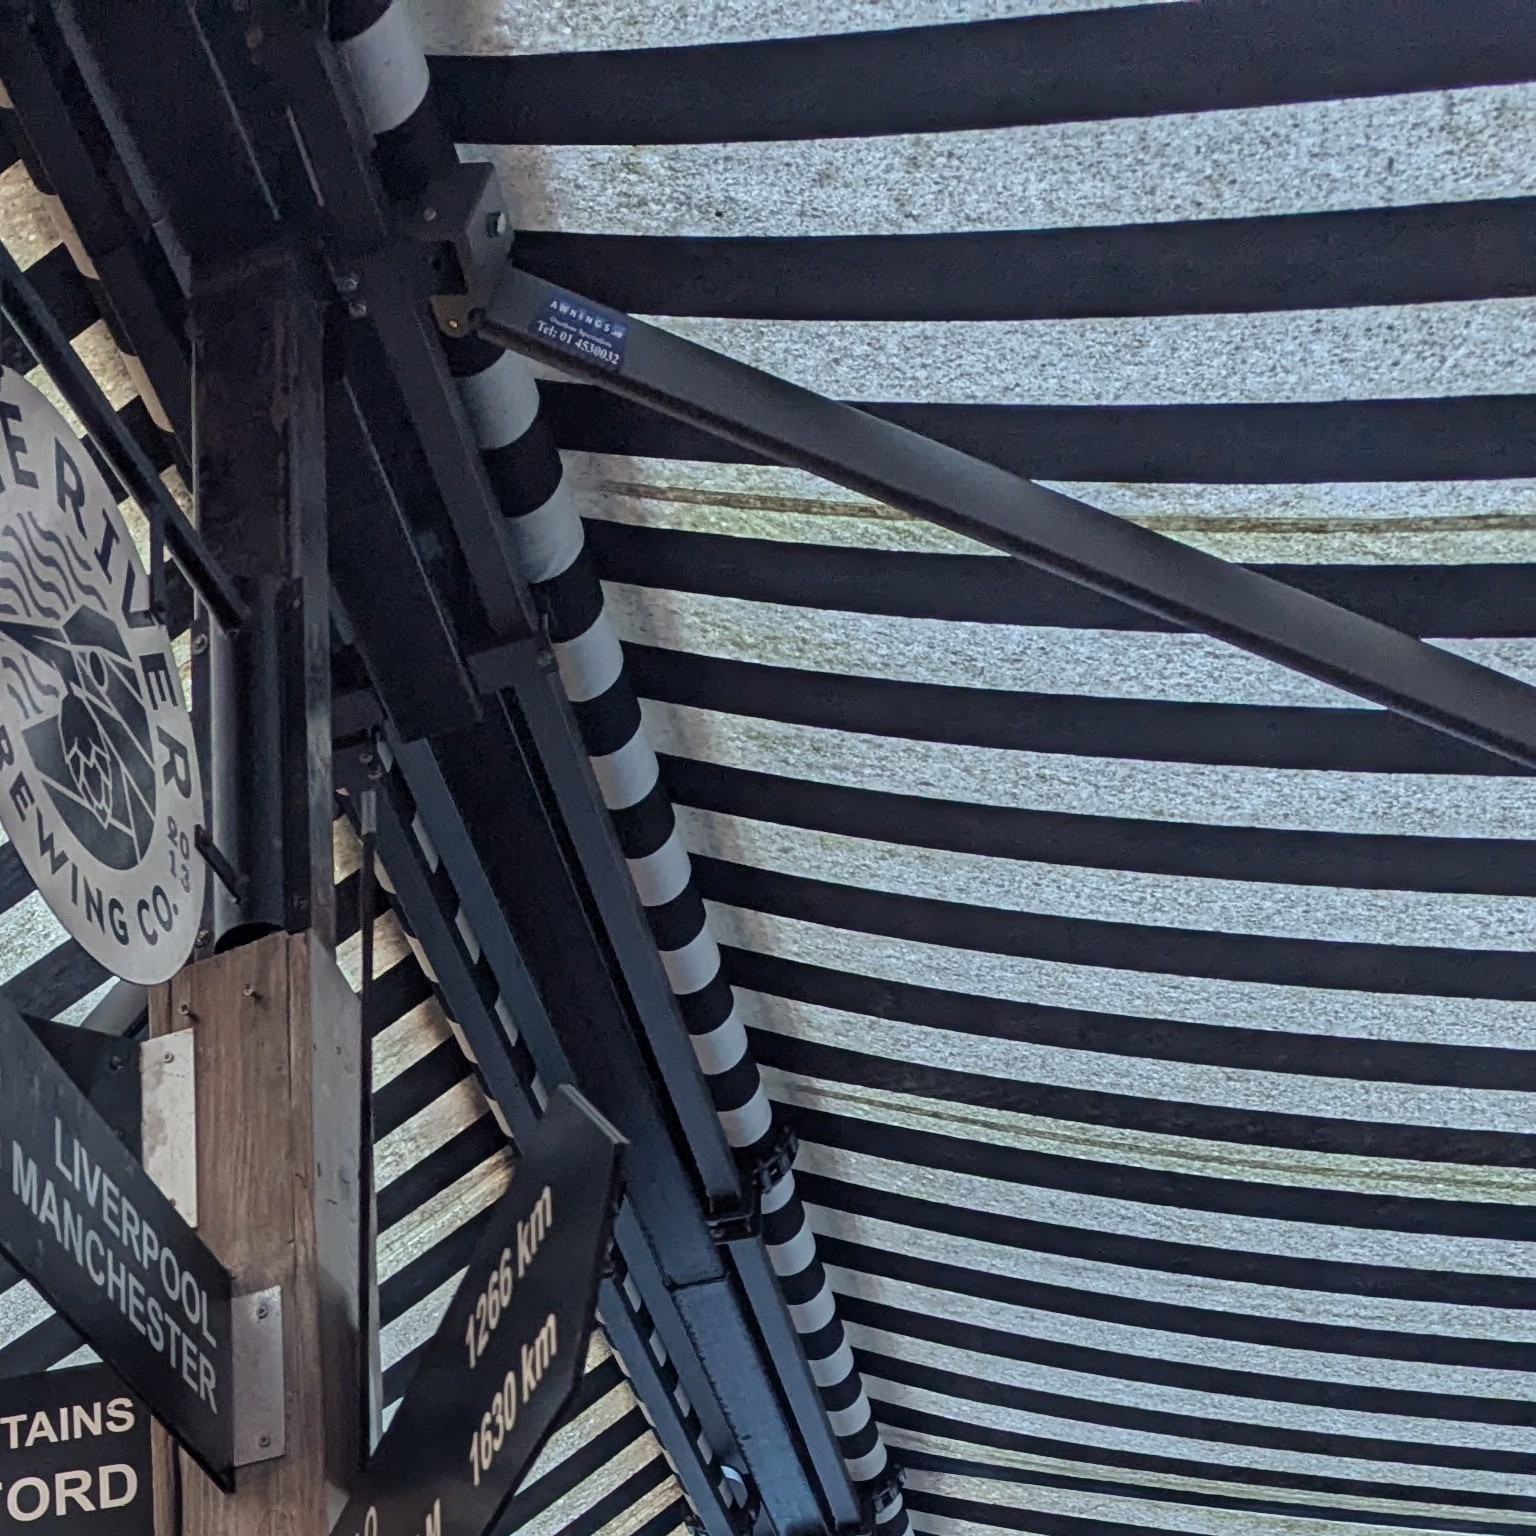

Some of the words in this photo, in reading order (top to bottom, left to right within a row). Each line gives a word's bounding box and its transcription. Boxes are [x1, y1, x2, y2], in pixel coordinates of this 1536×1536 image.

[54, 437, 193, 801] RIVER
[136, 883, 179, 945] CO.
[12, 1140, 219, 1414] MANCHESTER
[54, 1117, 217, 1348] LIVERPOOL
[464, 1248, 513, 1370] 1266
[516, 1185, 553, 1280] km
[467, 1370, 518, 1487] 1630
[519, 1312, 557, 1401] km
